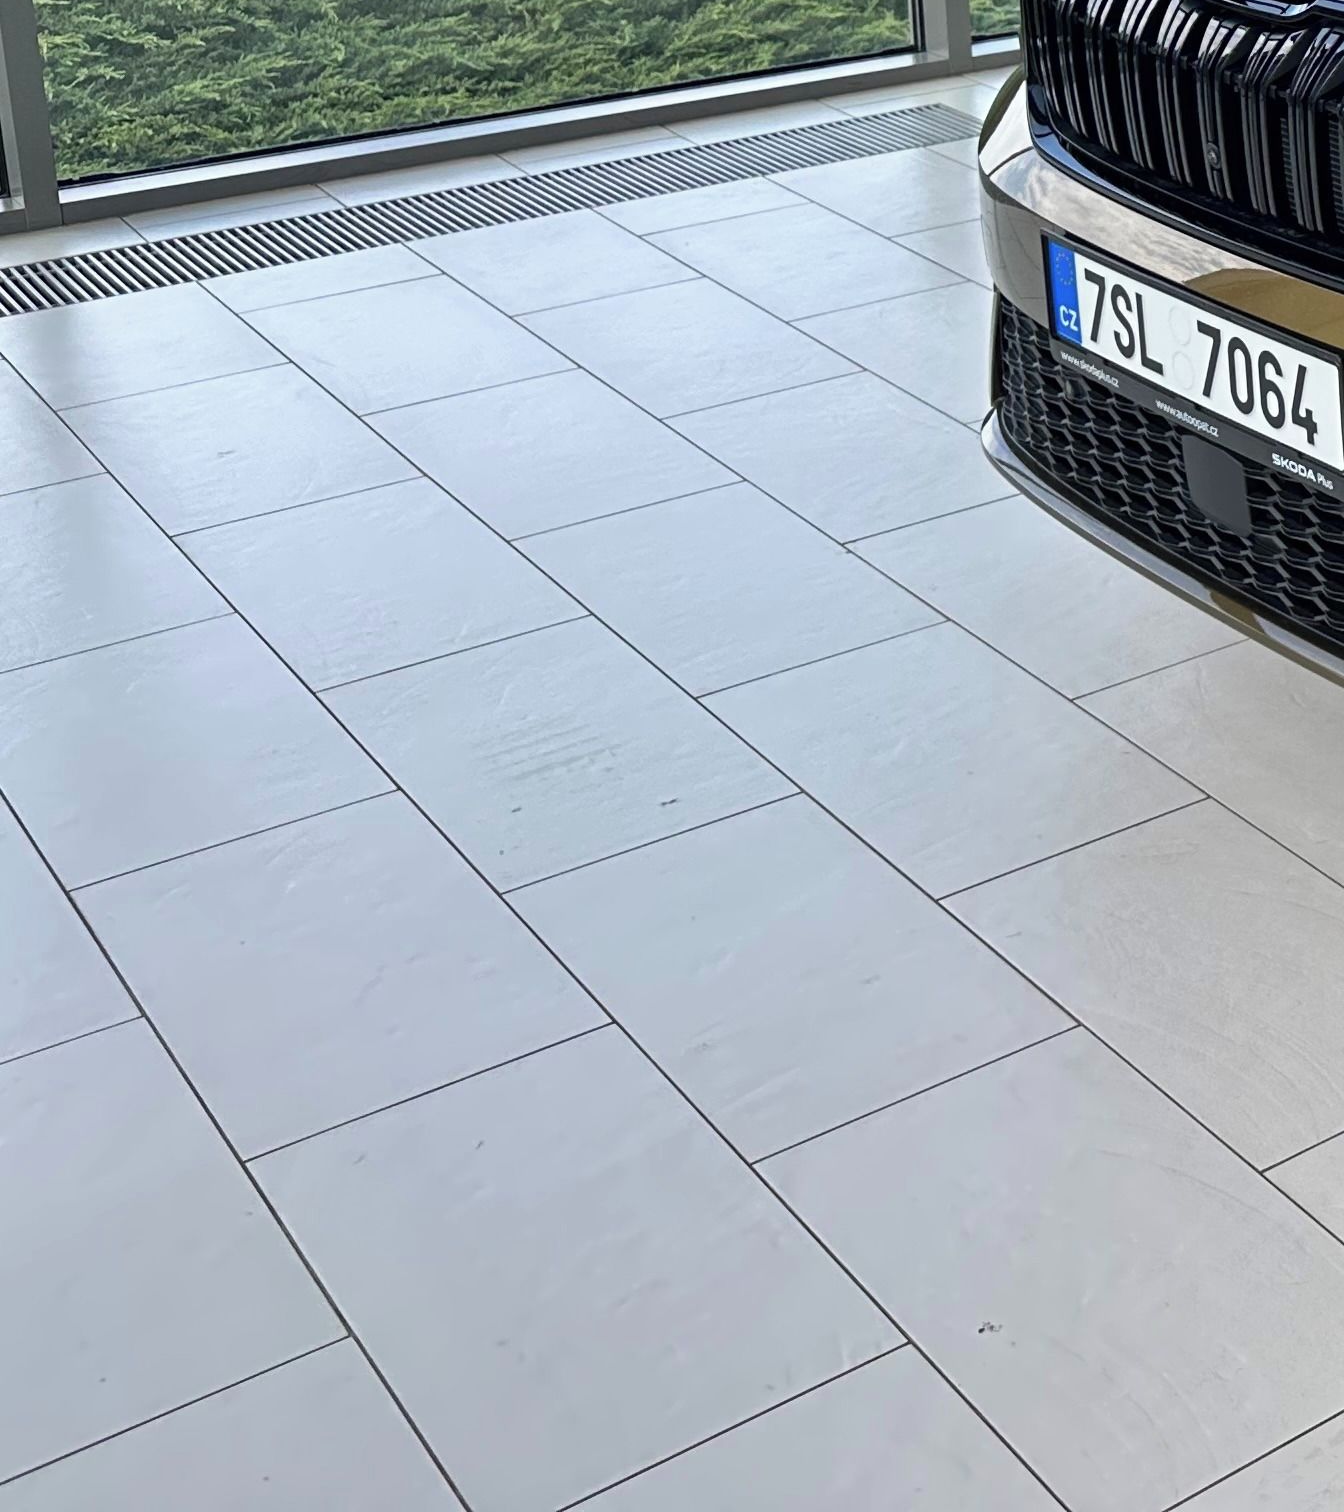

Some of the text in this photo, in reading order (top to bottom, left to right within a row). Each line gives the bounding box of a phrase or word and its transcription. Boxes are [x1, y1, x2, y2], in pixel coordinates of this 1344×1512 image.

[1059, 304, 1079, 332] CZ
[1084, 267, 1318, 447] 7SL 7064
